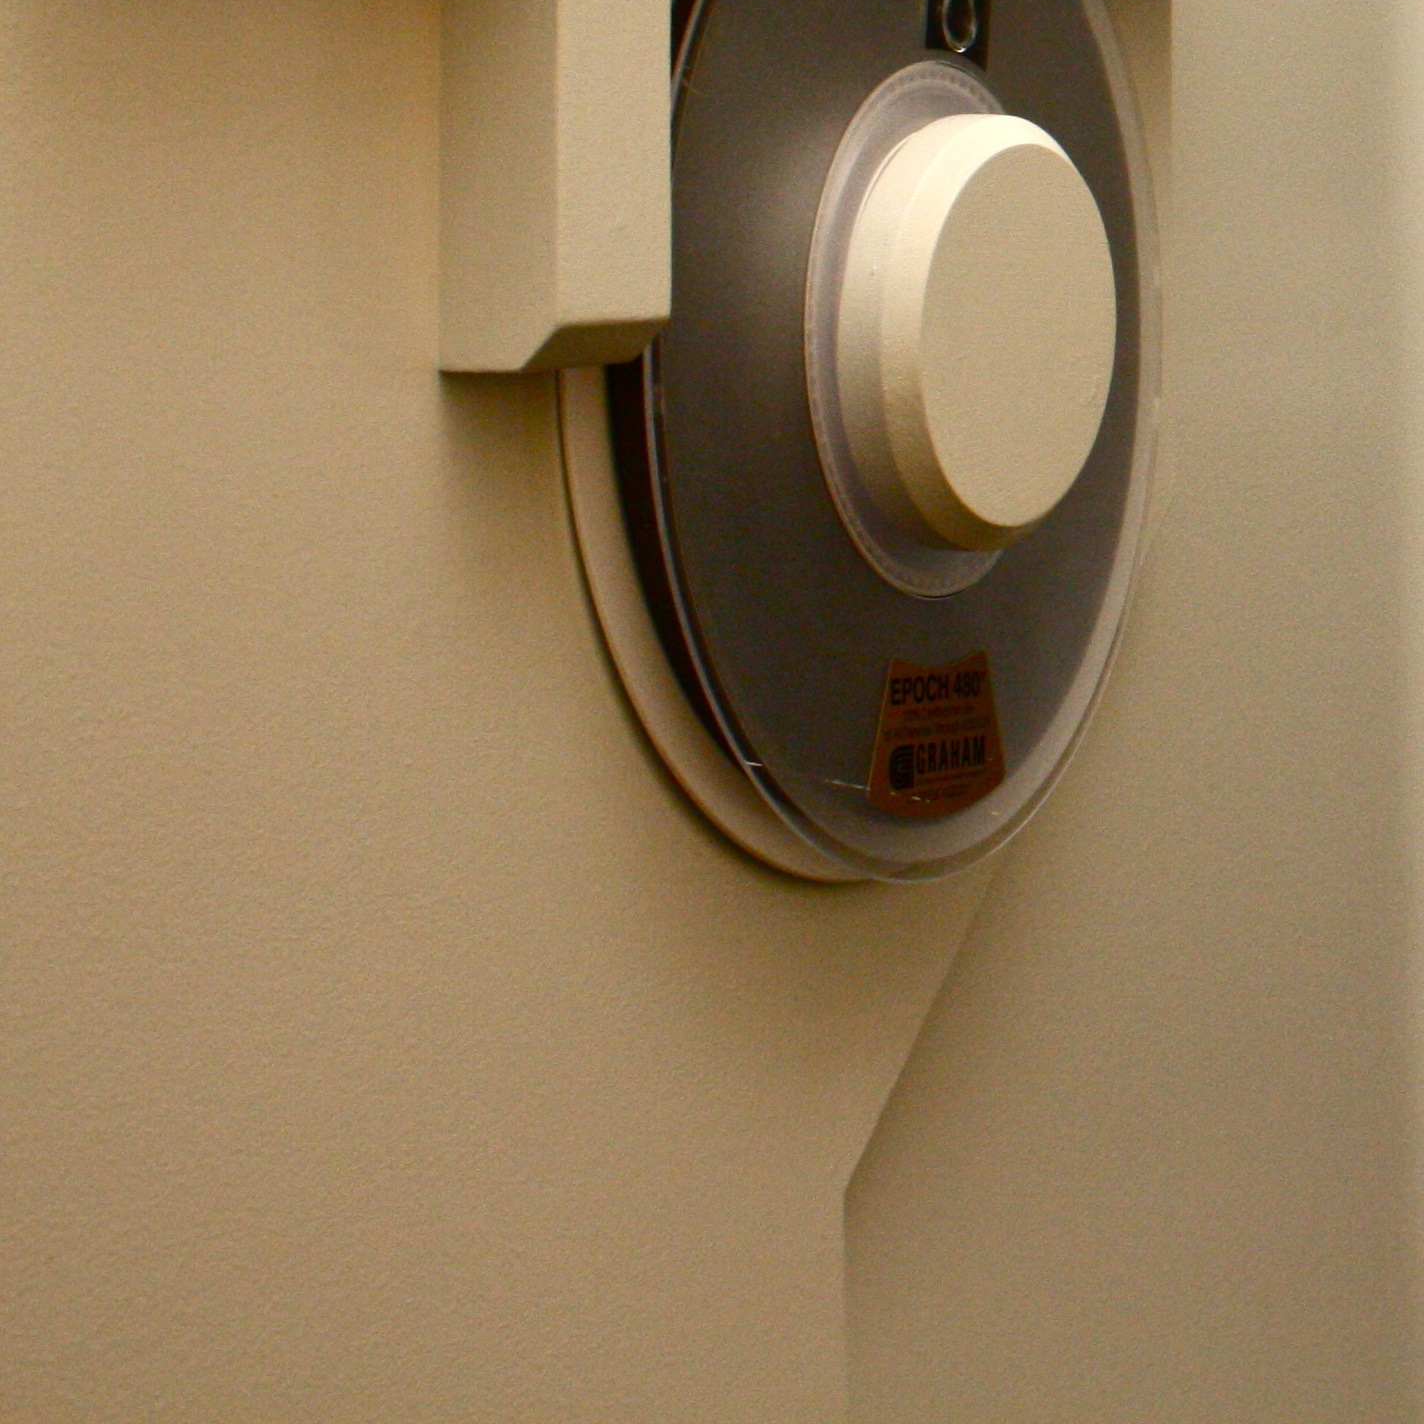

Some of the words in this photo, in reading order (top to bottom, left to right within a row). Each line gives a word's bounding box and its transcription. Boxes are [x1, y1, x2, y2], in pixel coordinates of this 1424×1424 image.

[890, 671, 949, 706] EPOCH
[953, 670, 983, 699] 480
[915, 735, 987, 775] GRAHAM
